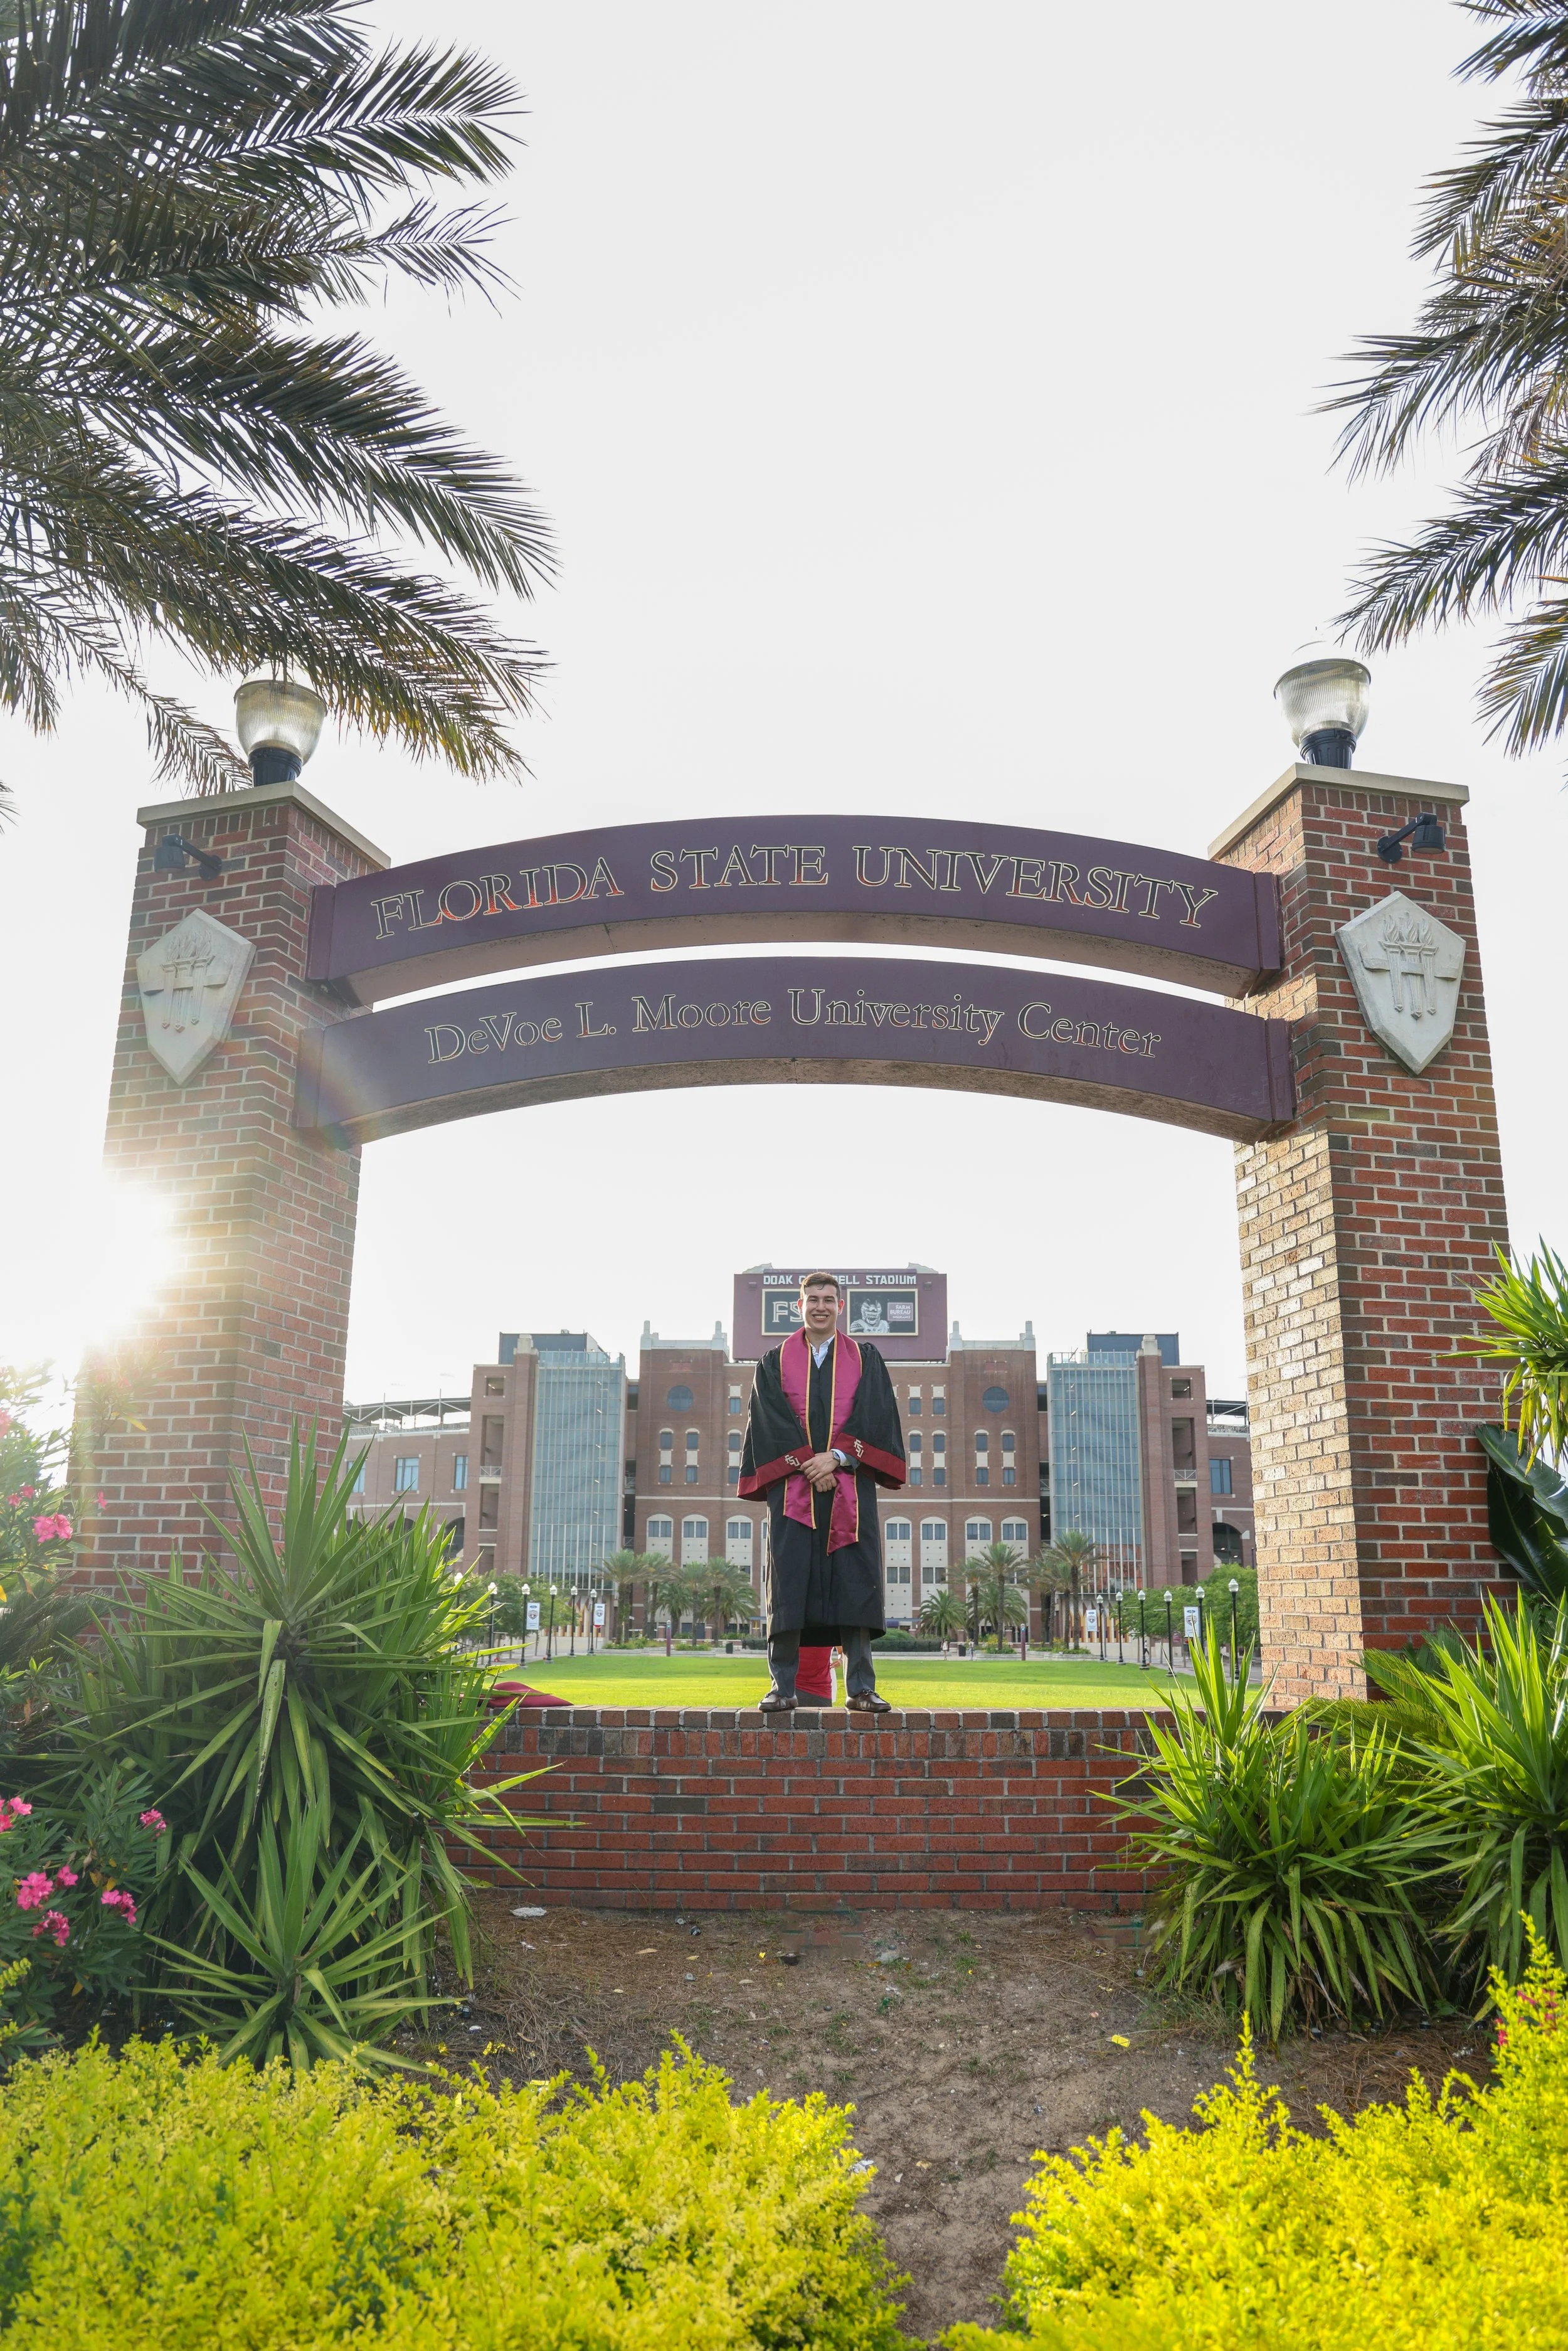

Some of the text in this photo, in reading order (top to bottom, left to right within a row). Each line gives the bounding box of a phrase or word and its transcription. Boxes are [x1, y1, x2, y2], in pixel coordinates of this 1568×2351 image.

[371, 844, 1219, 940] FLORIDA STATE UNIVERSITY
[424, 988, 1162, 1064] DeVoe L. Moore University Center
[763, 1275, 793, 1285] DOAK
[866, 1275, 916, 1285] STADIUM
[854, 1438, 864, 1458] FSU
[784, 1454, 800, 1467] FSU
